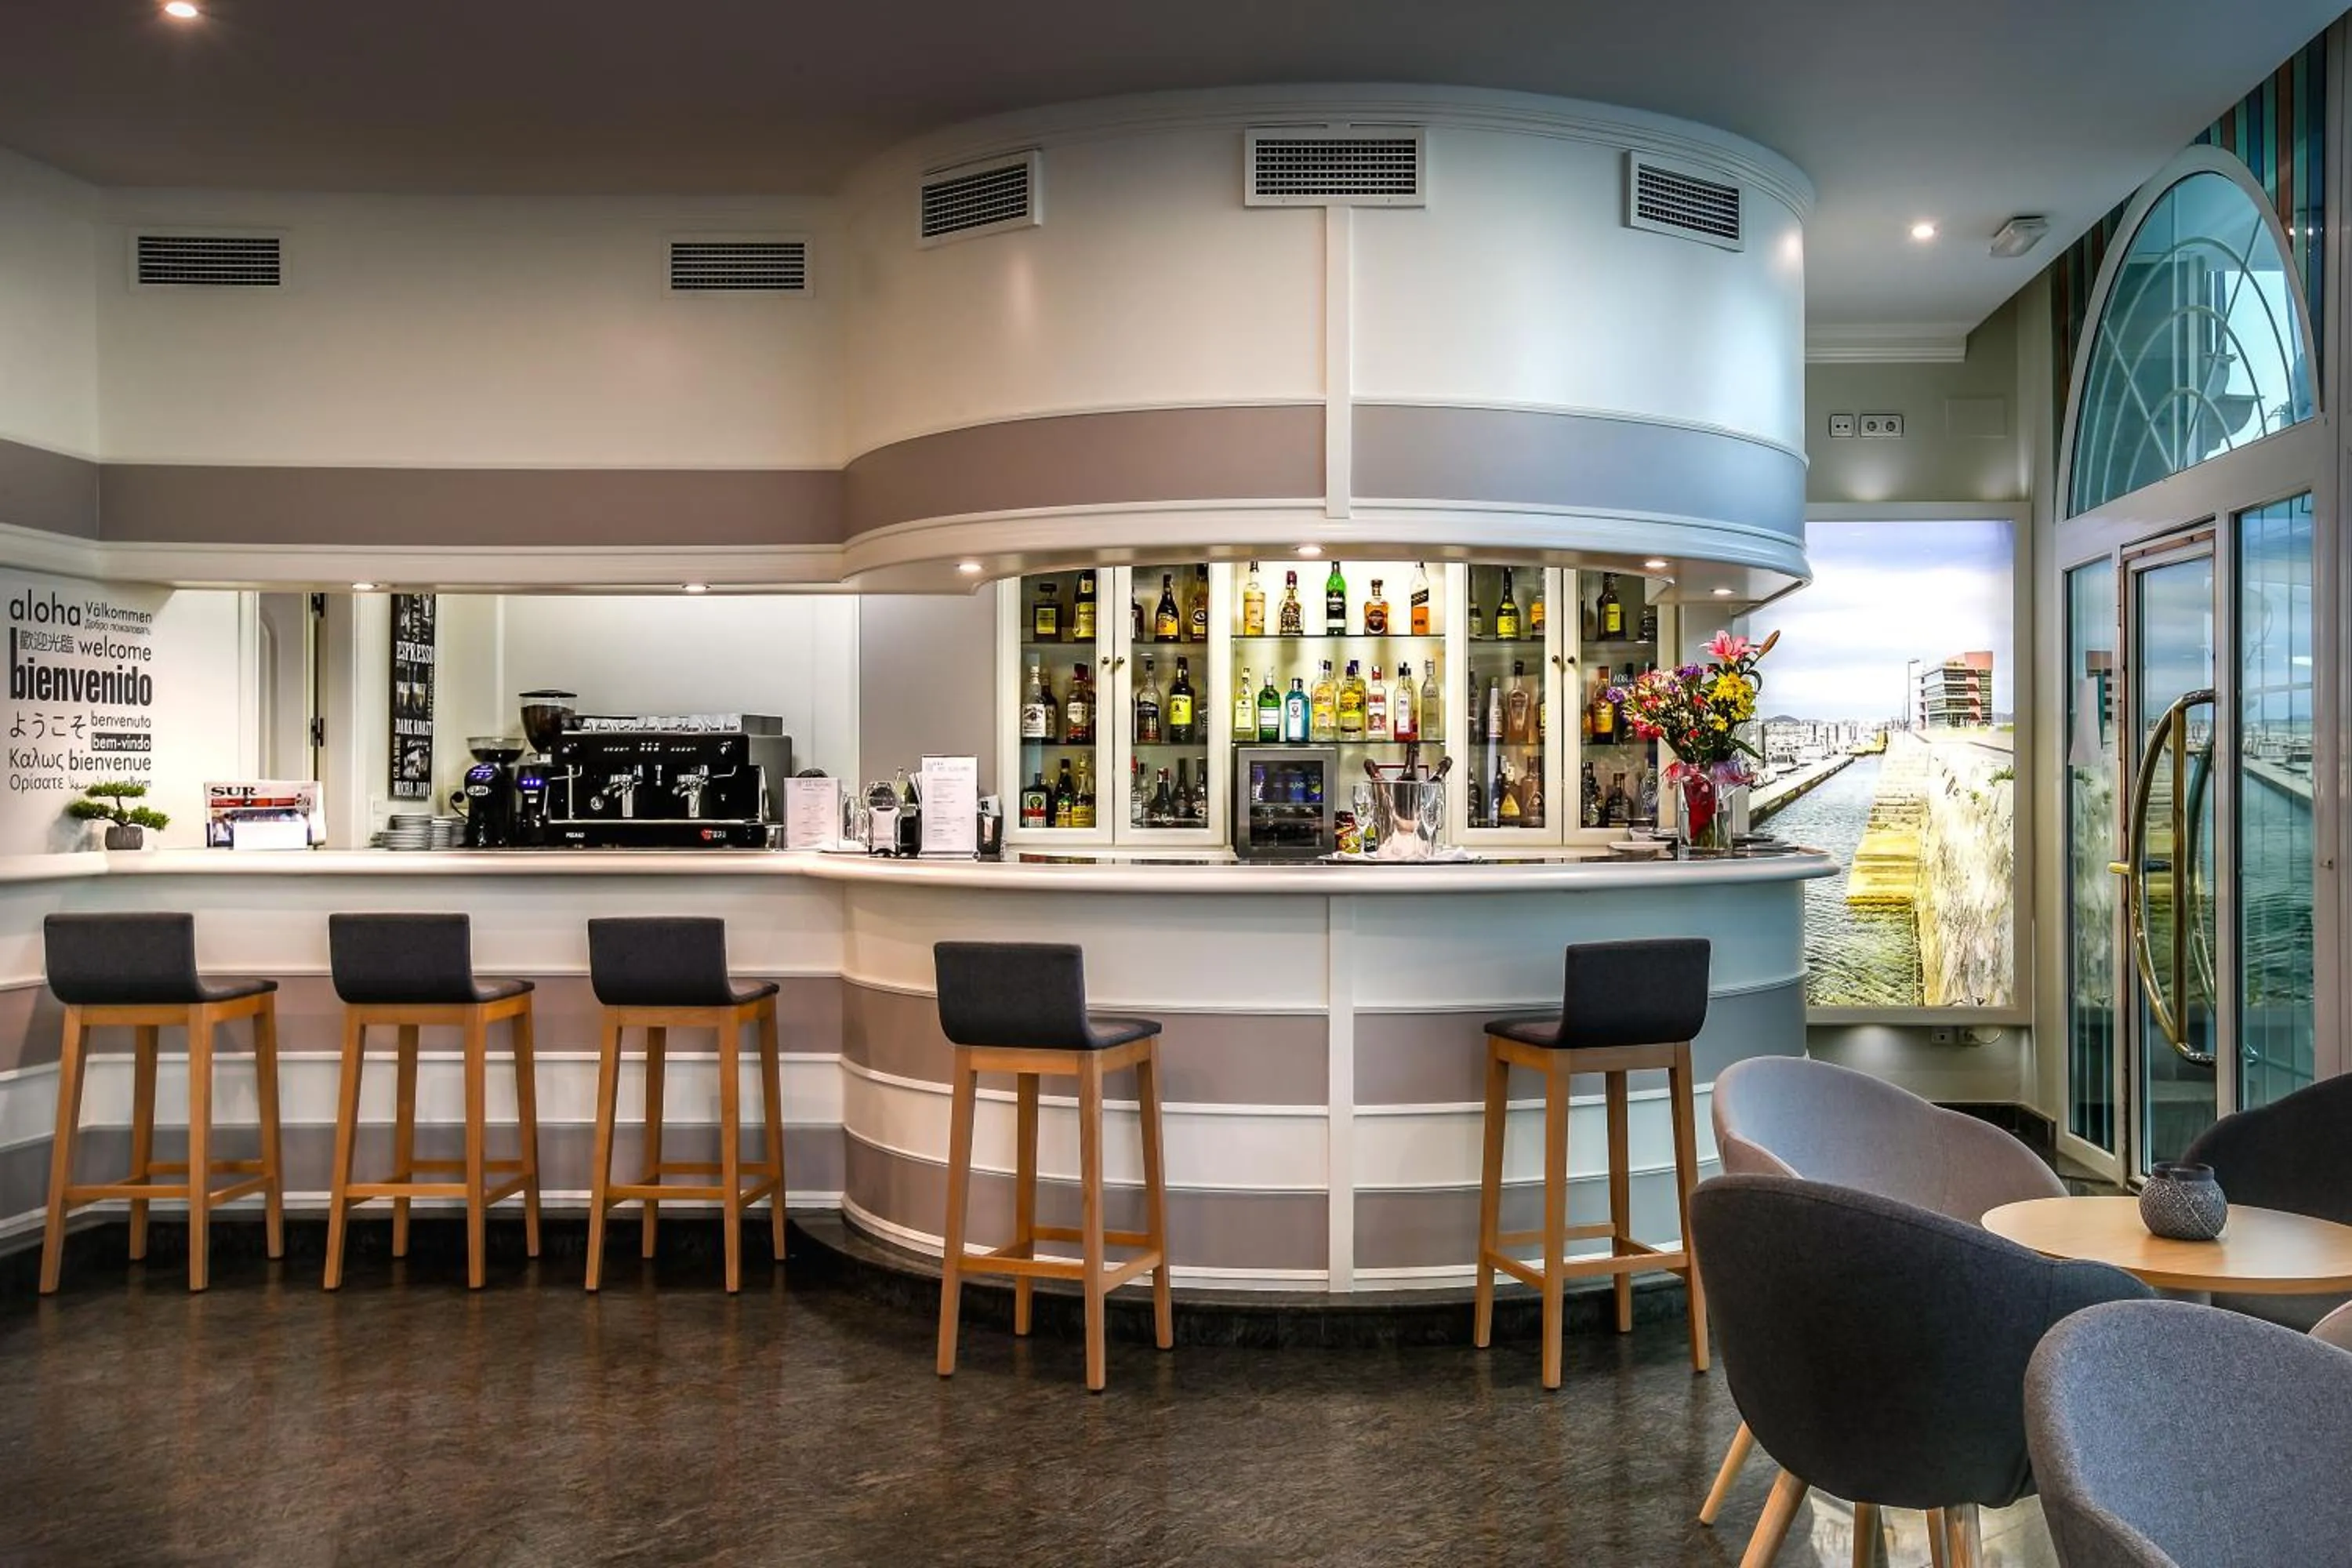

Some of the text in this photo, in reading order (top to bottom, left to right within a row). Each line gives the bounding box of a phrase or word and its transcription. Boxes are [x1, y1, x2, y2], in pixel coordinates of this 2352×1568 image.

[9, 589, 81, 626] aloha
[78, 636, 151, 662] welcome
[9, 627, 153, 706] bienvenido
[9, 710, 86, 739] ようこそ
[91, 710, 151, 729] benvenuto
[93, 734, 151, 750] bem-vindo
[68, 748, 151, 771] bienvenue
[210, 786, 257, 797] SUR
